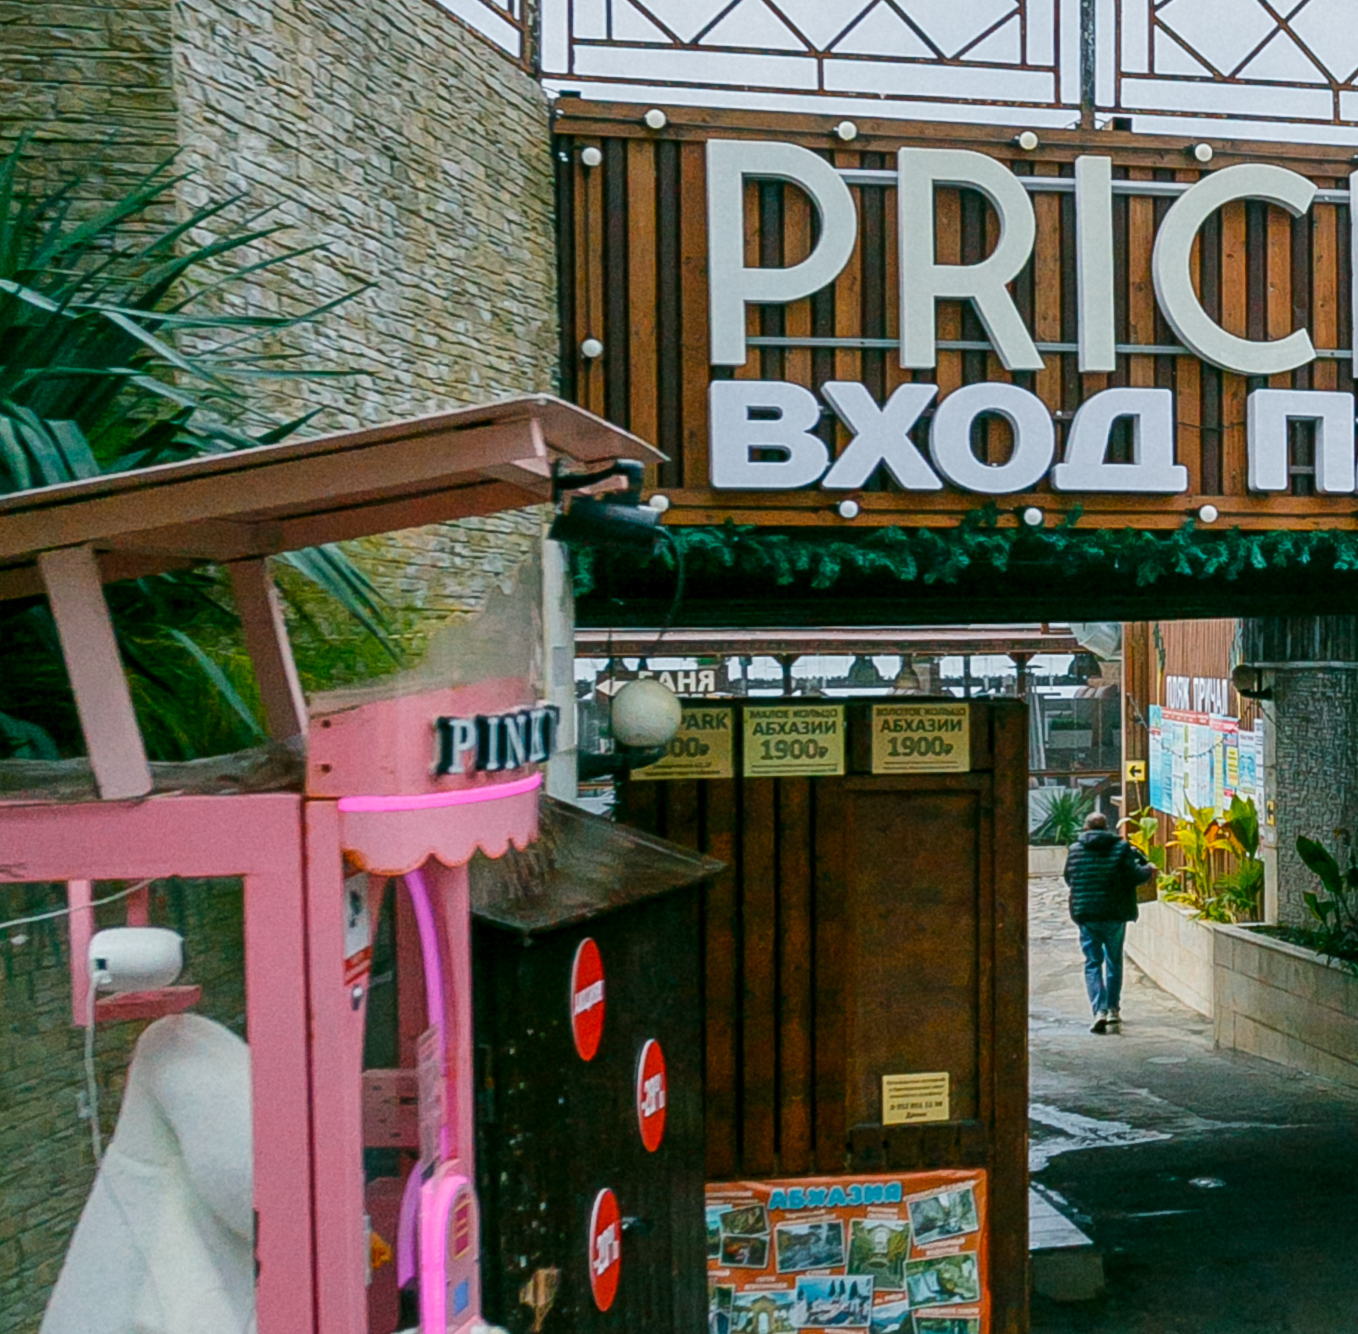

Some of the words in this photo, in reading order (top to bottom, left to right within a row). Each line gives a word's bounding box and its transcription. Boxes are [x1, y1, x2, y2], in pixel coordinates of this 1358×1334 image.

[708, 380, 1189, 494] ВХОД
[752, 720, 837, 736] АБХАЗИИ
[879, 719, 962, 733] АБХАЗИИ
[767, 1181, 903, 1210] АБХАЗИЯ
